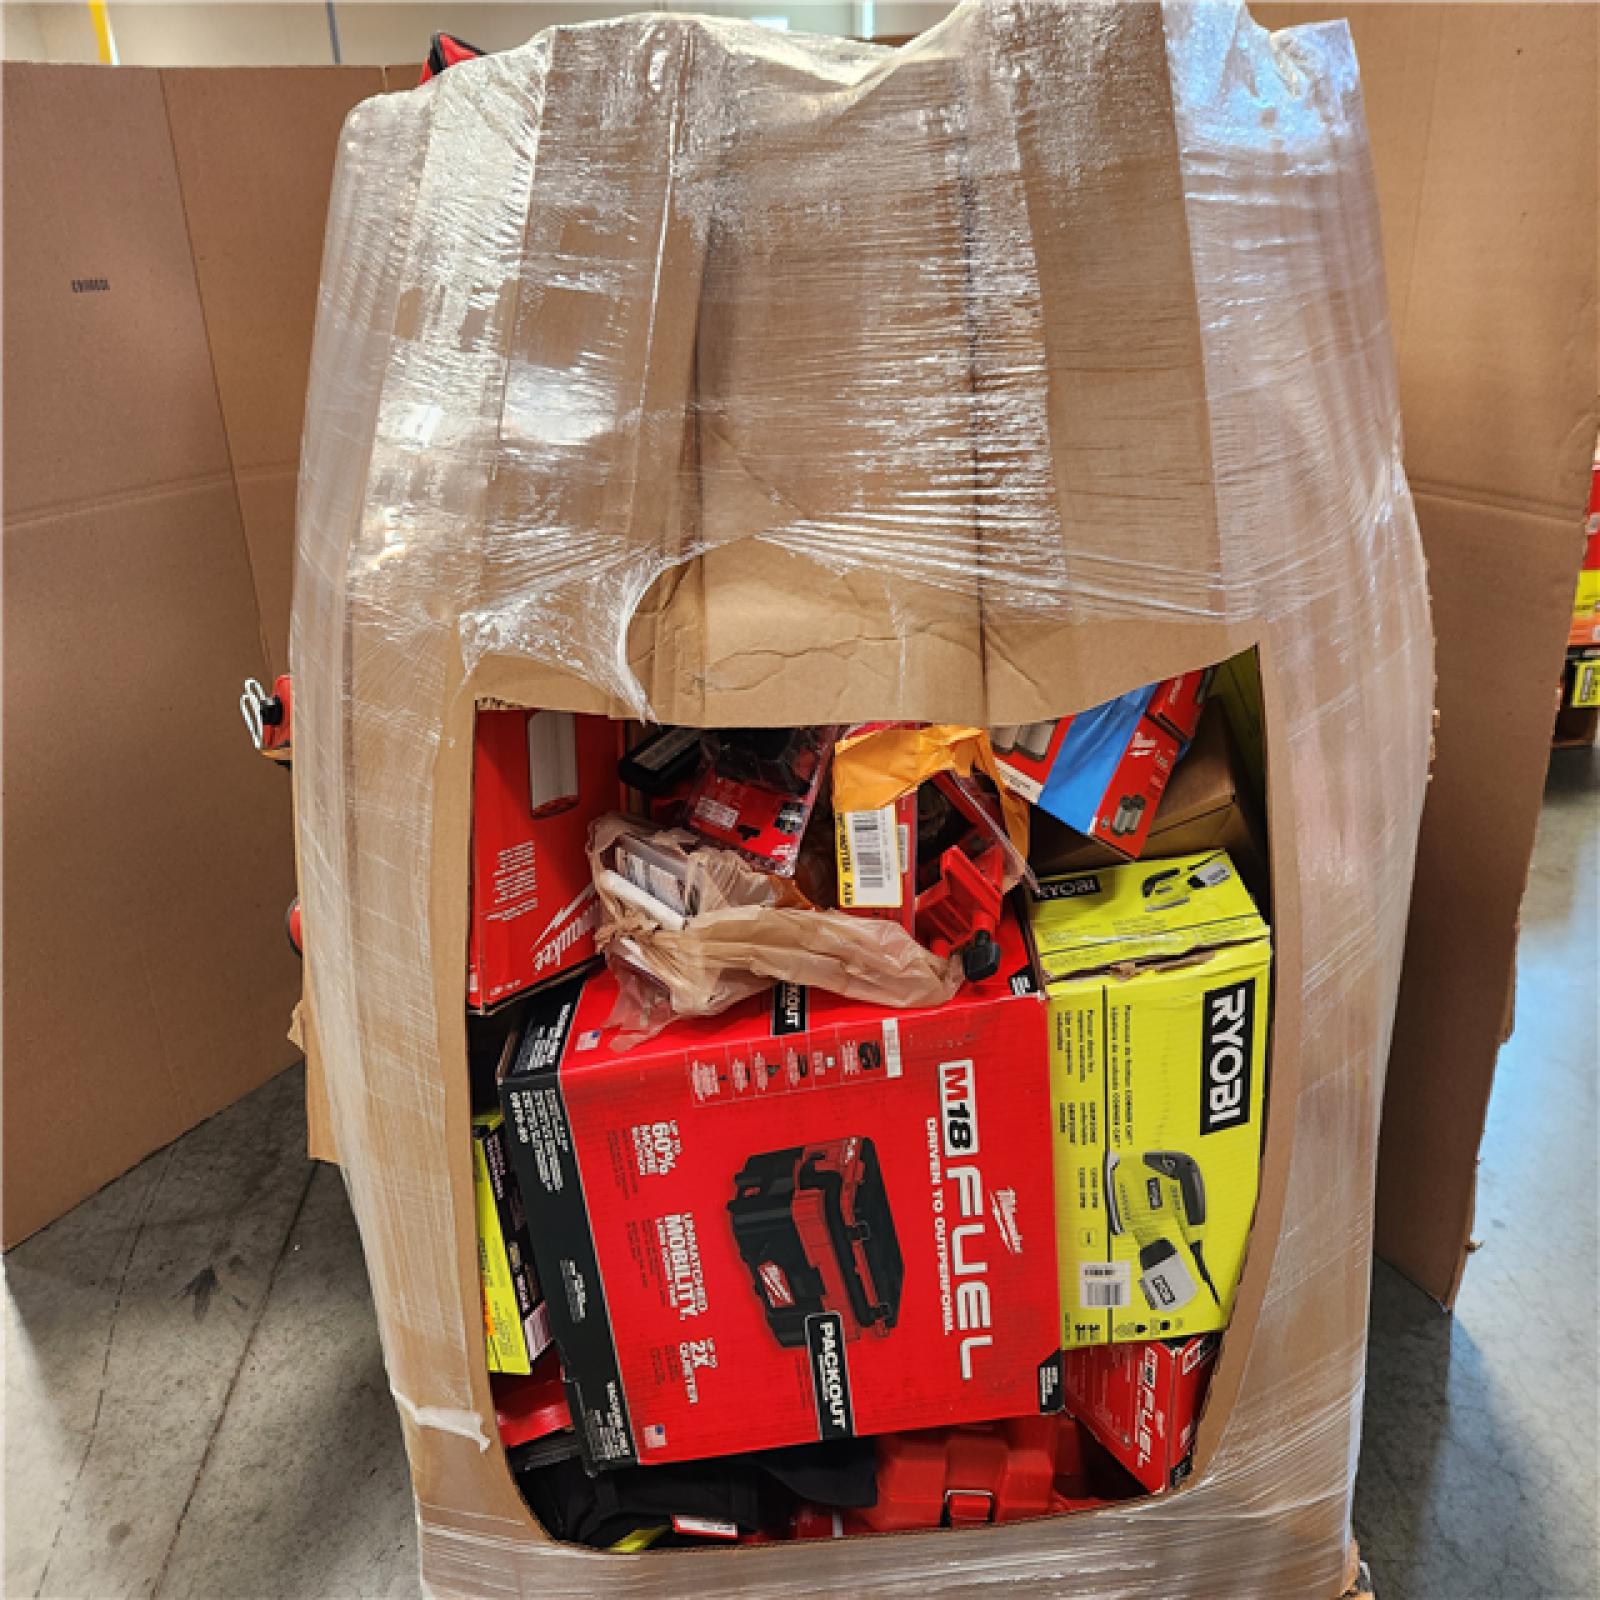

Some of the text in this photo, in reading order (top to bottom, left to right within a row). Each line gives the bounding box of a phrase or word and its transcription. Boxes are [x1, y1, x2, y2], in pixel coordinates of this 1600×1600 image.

[1210, 988, 1245, 1122] RYOBI
[652, 1122, 675, 1174] 60%
[927, 1117, 942, 1185] DRIVEN
[932, 1188, 944, 1213] TO
[942, 1064, 992, 1381] M18 FUEL
[820, 1322, 846, 1430] PACKOUT
